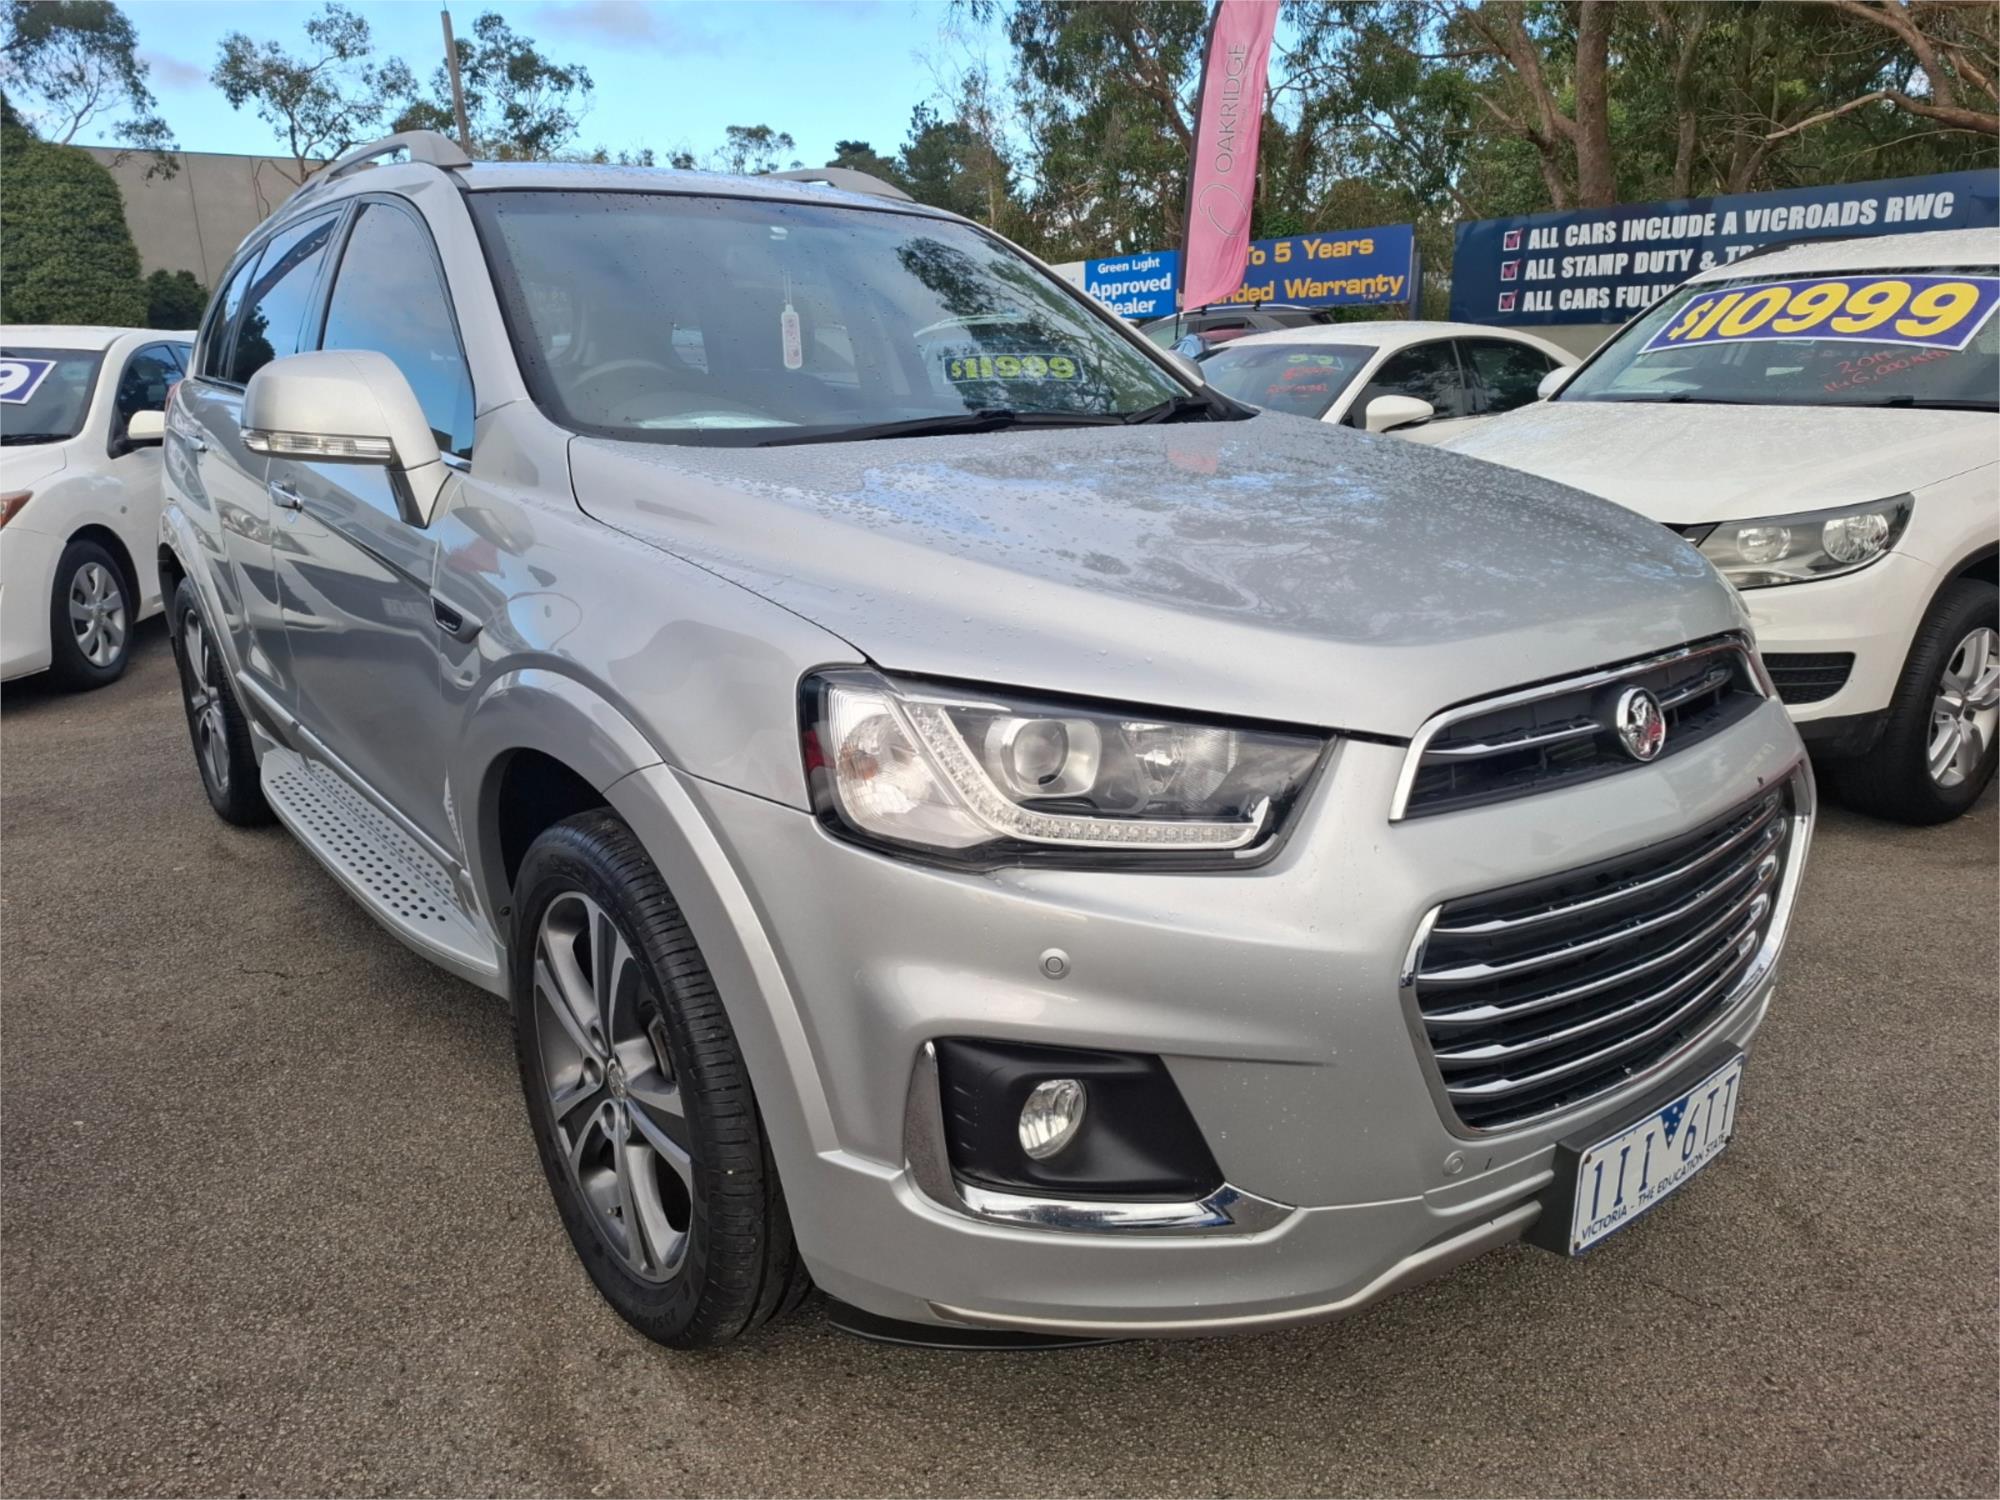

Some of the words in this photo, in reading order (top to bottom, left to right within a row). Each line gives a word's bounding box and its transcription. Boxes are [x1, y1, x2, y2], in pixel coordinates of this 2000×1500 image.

[1215, 41, 1245, 173] OAKRIDGE
[1528, 228, 1559, 250] ALL
[1564, 220, 1617, 247] CARS
[1621, 213, 1716, 243] INCLUDE
[1721, 211, 1738, 235] A
[1745, 199, 1877, 233] VICROADS
[1884, 191, 1954, 223] RWC
[1274, 241, 1292, 263] 5
[1302, 238, 1374, 260] Years
[1524, 258, 1556, 281] ALL
[1561, 252, 1628, 279] STAMP
[1633, 248, 1694, 274] DUTY
[1699, 251, 1717, 270] &
[1097, 263, 1130, 275] Green
[1132, 257, 1161, 272] Light
[1089, 272, 1172, 300] Approved
[1284, 273, 1404, 300] Warranty
[1522, 290, 1554, 312] ALL
[1559, 287, 1611, 310] CARS
[1668, 280, 1980, 341] $10999
[951, 355, 1075, 379] $11999
[1581, 1204, 1628, 1240] VICTORIA
[1638, 1186, 1655, 1206] THE
[1656, 1153, 1704, 1195] EDUCATION
